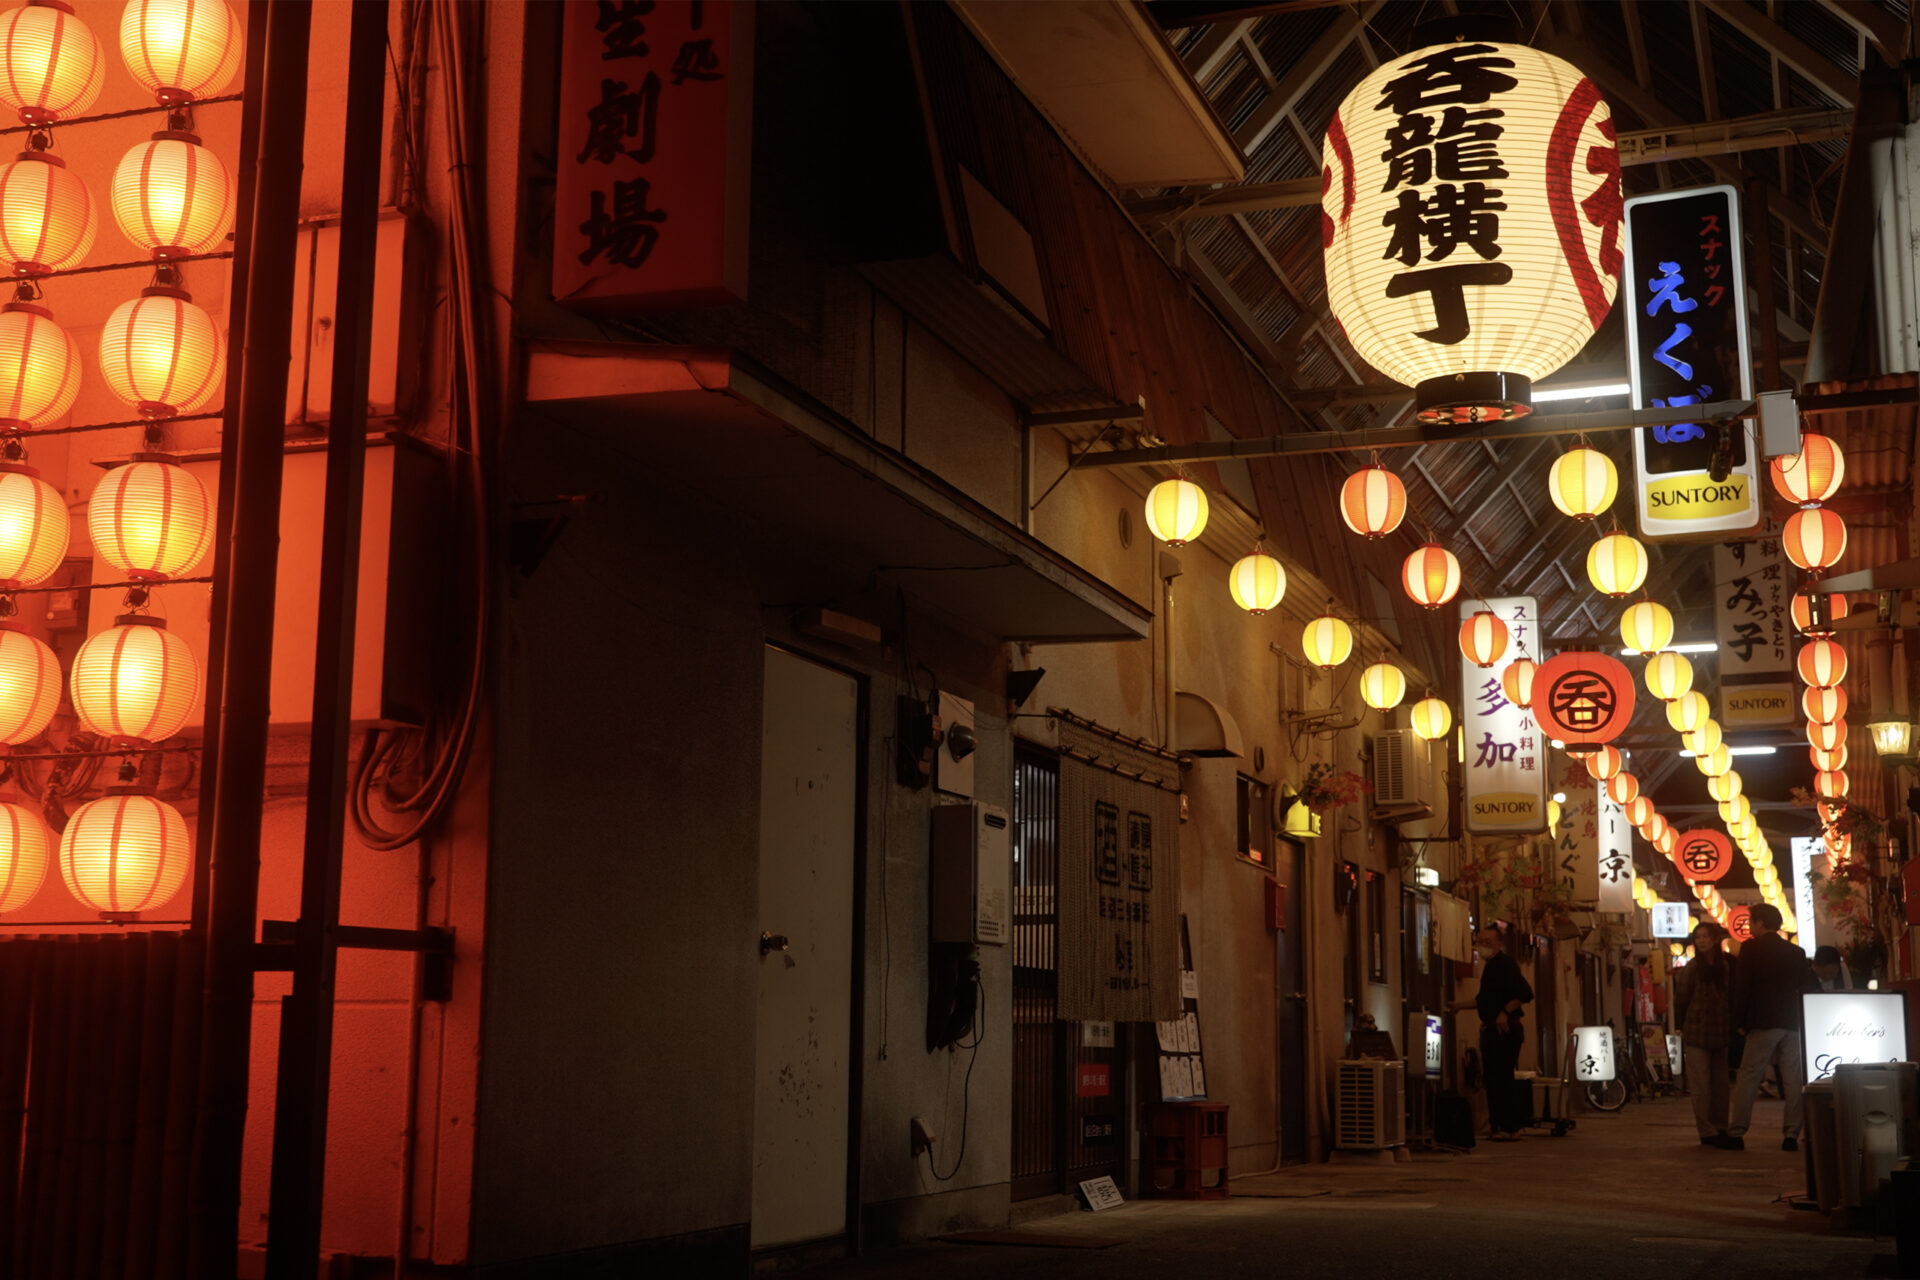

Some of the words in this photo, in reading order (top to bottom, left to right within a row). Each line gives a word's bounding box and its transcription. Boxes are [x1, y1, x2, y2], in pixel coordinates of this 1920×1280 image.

[1374, 44, 1518, 345] 呑龍横丁
[1700, 214, 1725, 308] スナック
[1650, 484, 1744, 508] SUNTORY
[1723, 540, 1768, 663] すみっ子
[1513, 606, 1527, 651] スナッ
[1474, 677, 1518, 769] 多加
[1554, 680, 1614, 726] 呑
[1729, 697, 1787, 711] SUNTORY
[1519, 716, 1535, 771] 小料理
[1475, 801, 1535, 815] SUNTORY
[1580, 799, 1597, 839] 焼鳥
[1560, 807, 1580, 890] どんぐり
[1599, 848, 1630, 883] 京
[1684, 843, 1719, 870] 呑
[1580, 1054, 1600, 1075] 京
